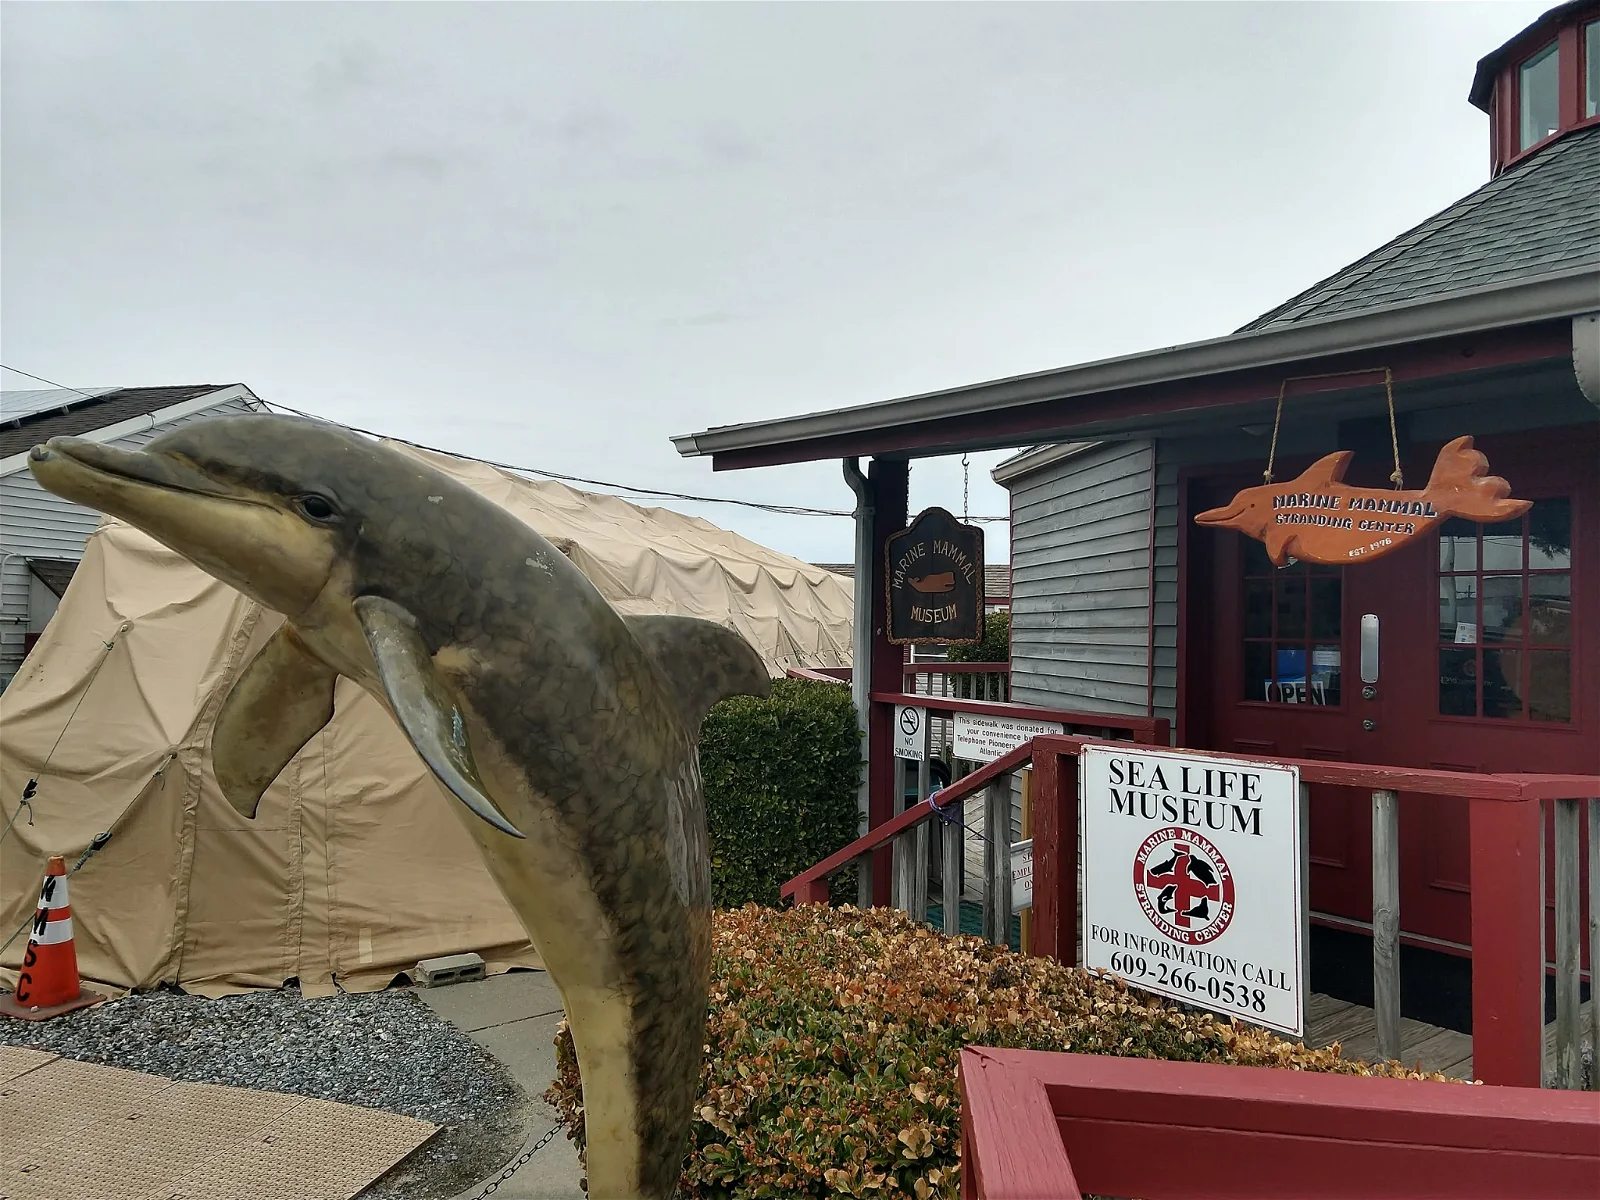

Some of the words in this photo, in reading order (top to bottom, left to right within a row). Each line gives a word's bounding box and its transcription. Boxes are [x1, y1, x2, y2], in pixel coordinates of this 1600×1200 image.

[1273, 492, 1342, 511] MARINE
[1348, 497, 1437, 518] MAMMAL
[1275, 513, 1353, 530] STRANDING
[1358, 519, 1415, 535] CENTER
[1348, 546, 1367, 557] EST.
[892, 542, 926, 589] MARINE
[933, 540, 977, 585] MAMMAL
[910, 604, 957, 623] MUSEUM
[1268, 683, 1323, 704] OPEN
[959, 716, 970, 725] This
[973, 718, 998, 728] sidewalk
[1016, 724, 1044, 733] donated
[1047, 727, 1058, 735] for
[982, 730, 1021, 740] convenience
[904, 737, 914, 746] NO
[957, 735, 986, 745] Telephone
[989, 739, 1016, 749] Pioneers
[895, 748, 923, 760] SMOKING
[1108, 758, 1169, 791] SEA
[1180, 766, 1263, 803] LIFE
[1108, 787, 1264, 836] MUSEUM
[1137, 828, 1177, 865] MARINE
[1180, 829, 1230, 881] MAMMAL
[1135, 883, 1190, 942] STRANDING
[1194, 901, 1233, 942] CENTER
[1091, 924, 1121, 946] FOR
[1124, 932, 1238, 976] INFORMATION
[1242, 963, 1292, 991] CALL
[1110, 951, 1267, 1013] 609-266-0538
